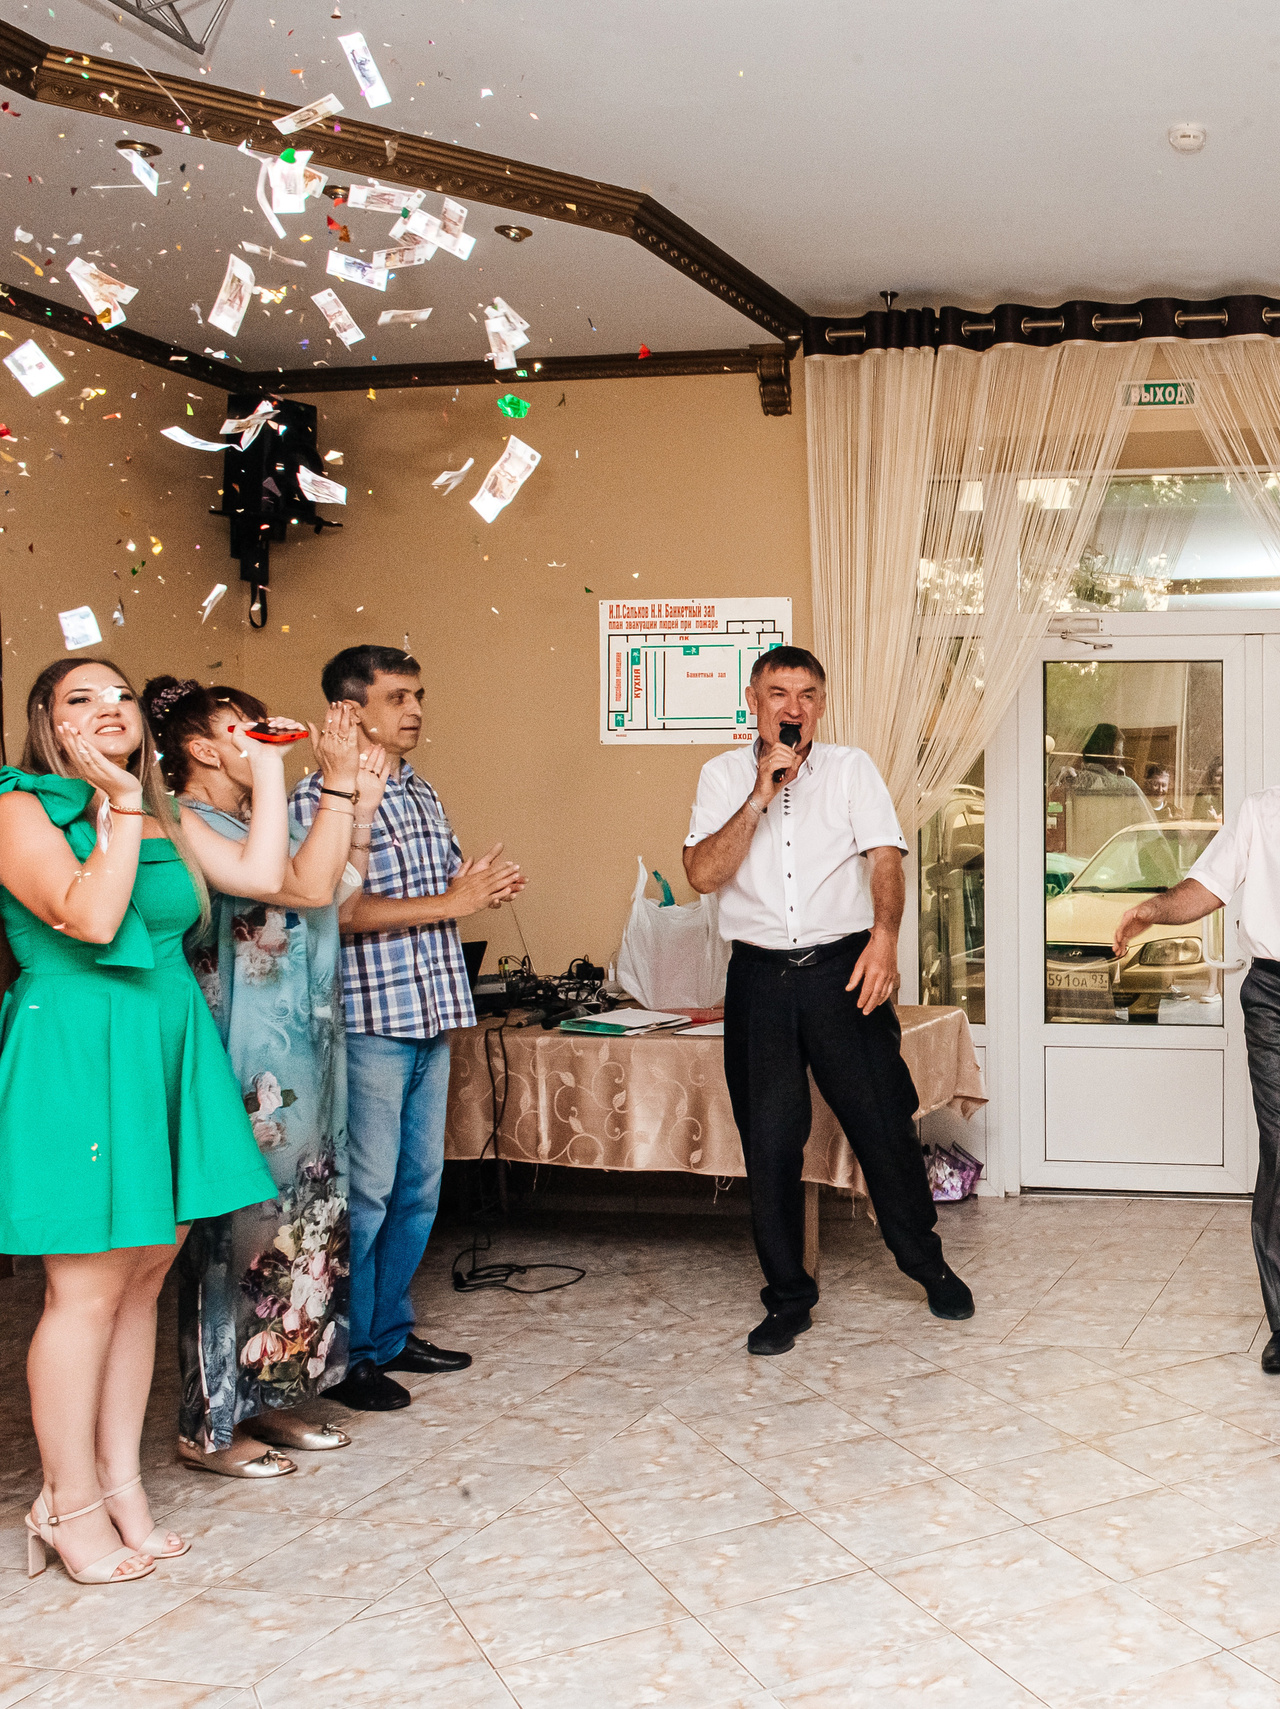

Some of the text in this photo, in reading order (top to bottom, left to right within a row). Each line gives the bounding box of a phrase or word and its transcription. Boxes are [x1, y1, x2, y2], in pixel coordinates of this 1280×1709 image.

[1130, 386, 1187, 405] ВЫХОД
[703, 605, 716, 618] зал
[608, 620, 624, 630] план
[659, 619, 679, 630] людей
[680, 620, 692, 631] при
[695, 619, 719, 631] пожаре
